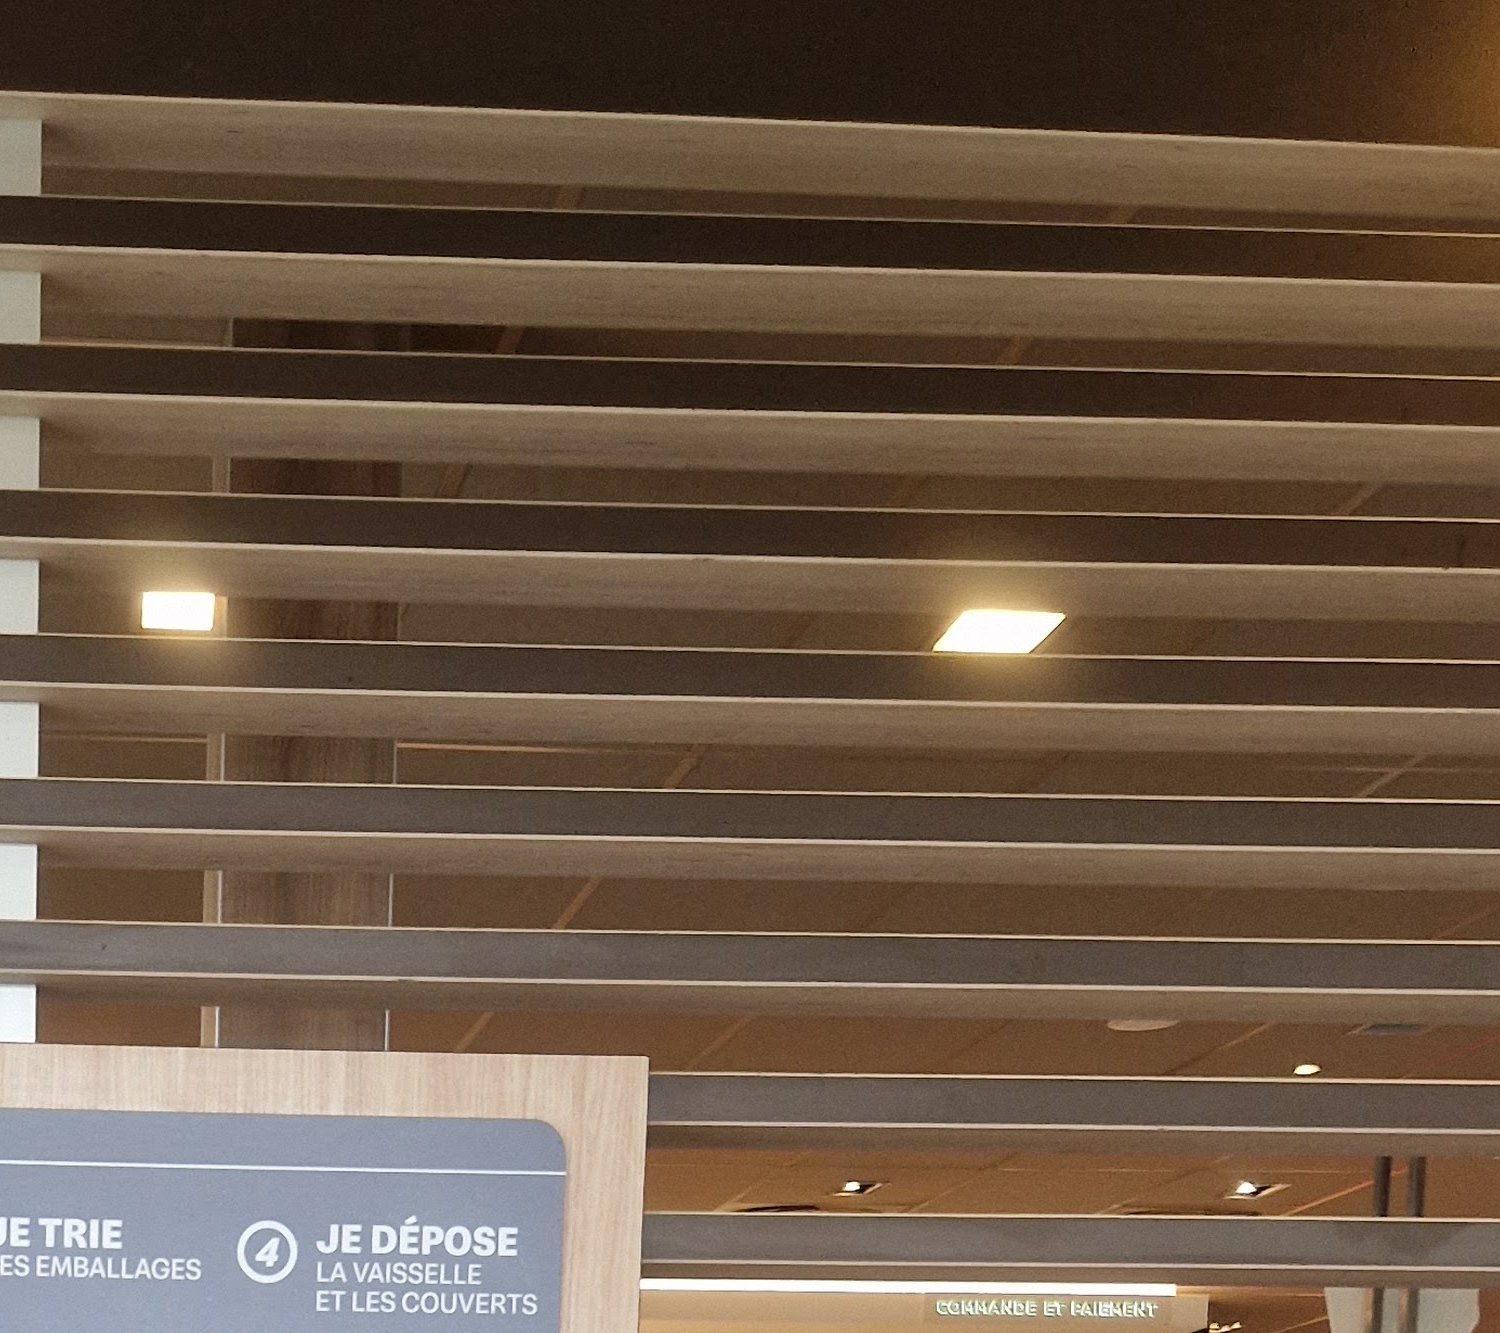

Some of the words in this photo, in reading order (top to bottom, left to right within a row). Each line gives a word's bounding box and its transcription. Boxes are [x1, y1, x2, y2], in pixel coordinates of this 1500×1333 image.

[38, 1218, 122, 1249] TRIE
[316, 1224, 362, 1253] JE
[372, 1215, 518, 1256] DÉPOSE
[255, 1238, 280, 1267] 4
[36, 1256, 201, 1280] EMBALLAGES
[317, 1262, 347, 1282] LA
[353, 1262, 481, 1284] VAISSELLE
[316, 1290, 346, 1311] ET
[352, 1291, 396, 1312] LES
[402, 1292, 537, 1315] COUVERTS
[937, 1299, 1037, 1315] COMMANDE
[1044, 1300, 1066, 1316] ET
[1071, 1301, 1158, 1317] PAIEMENT
